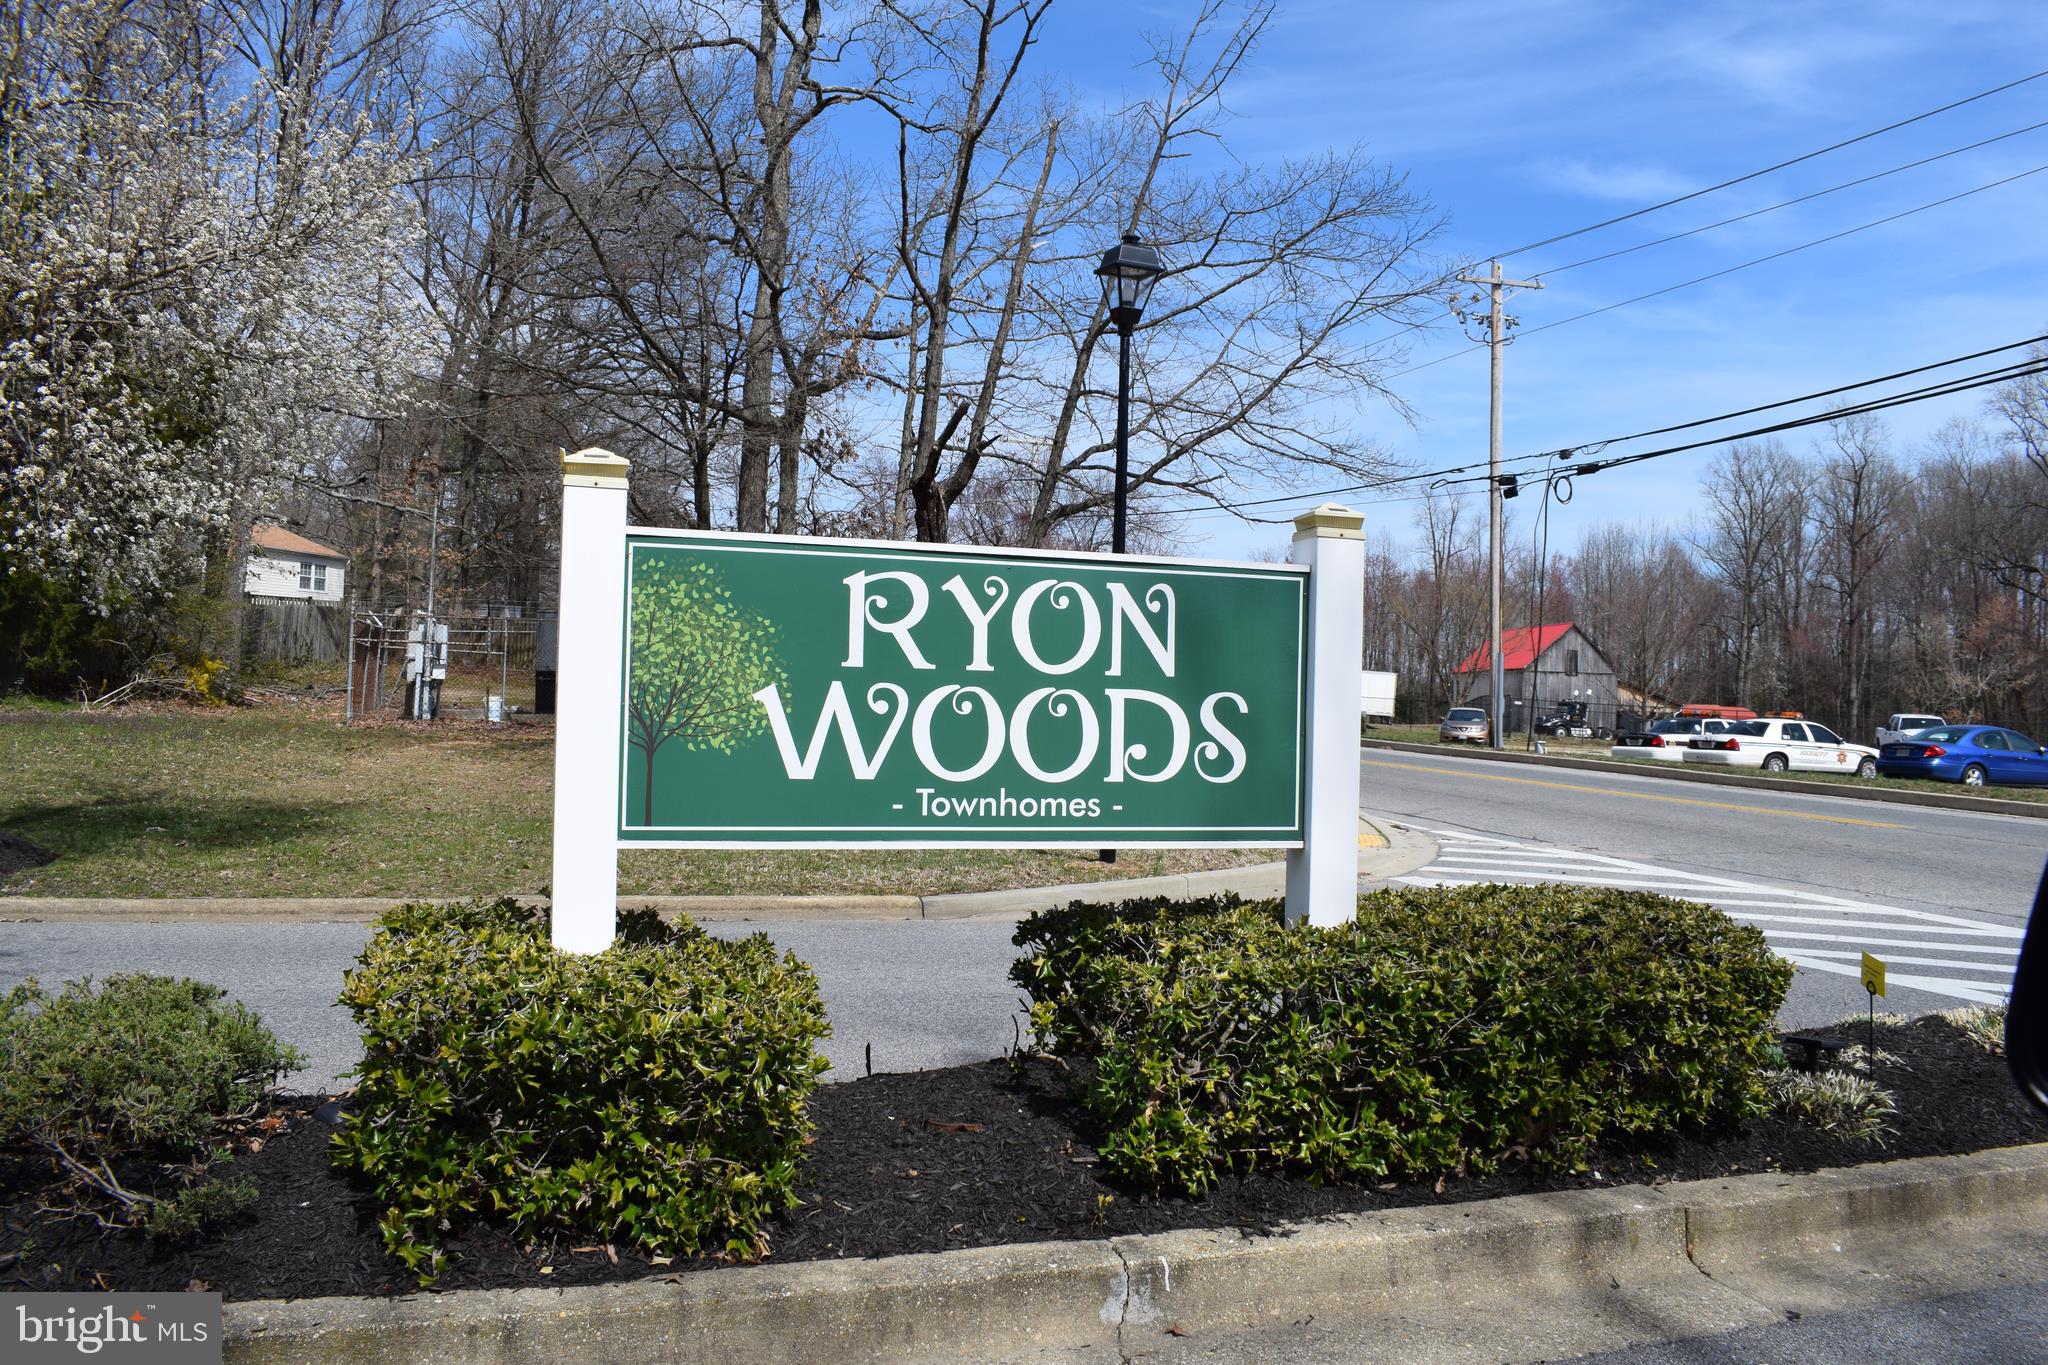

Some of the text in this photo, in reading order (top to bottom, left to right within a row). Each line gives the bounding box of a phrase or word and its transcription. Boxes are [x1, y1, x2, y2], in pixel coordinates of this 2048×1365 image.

[841, 569, 1176, 678] RYON
[750, 680, 1249, 784] WOODS
[915, 787, 1101, 818] Townhomes
